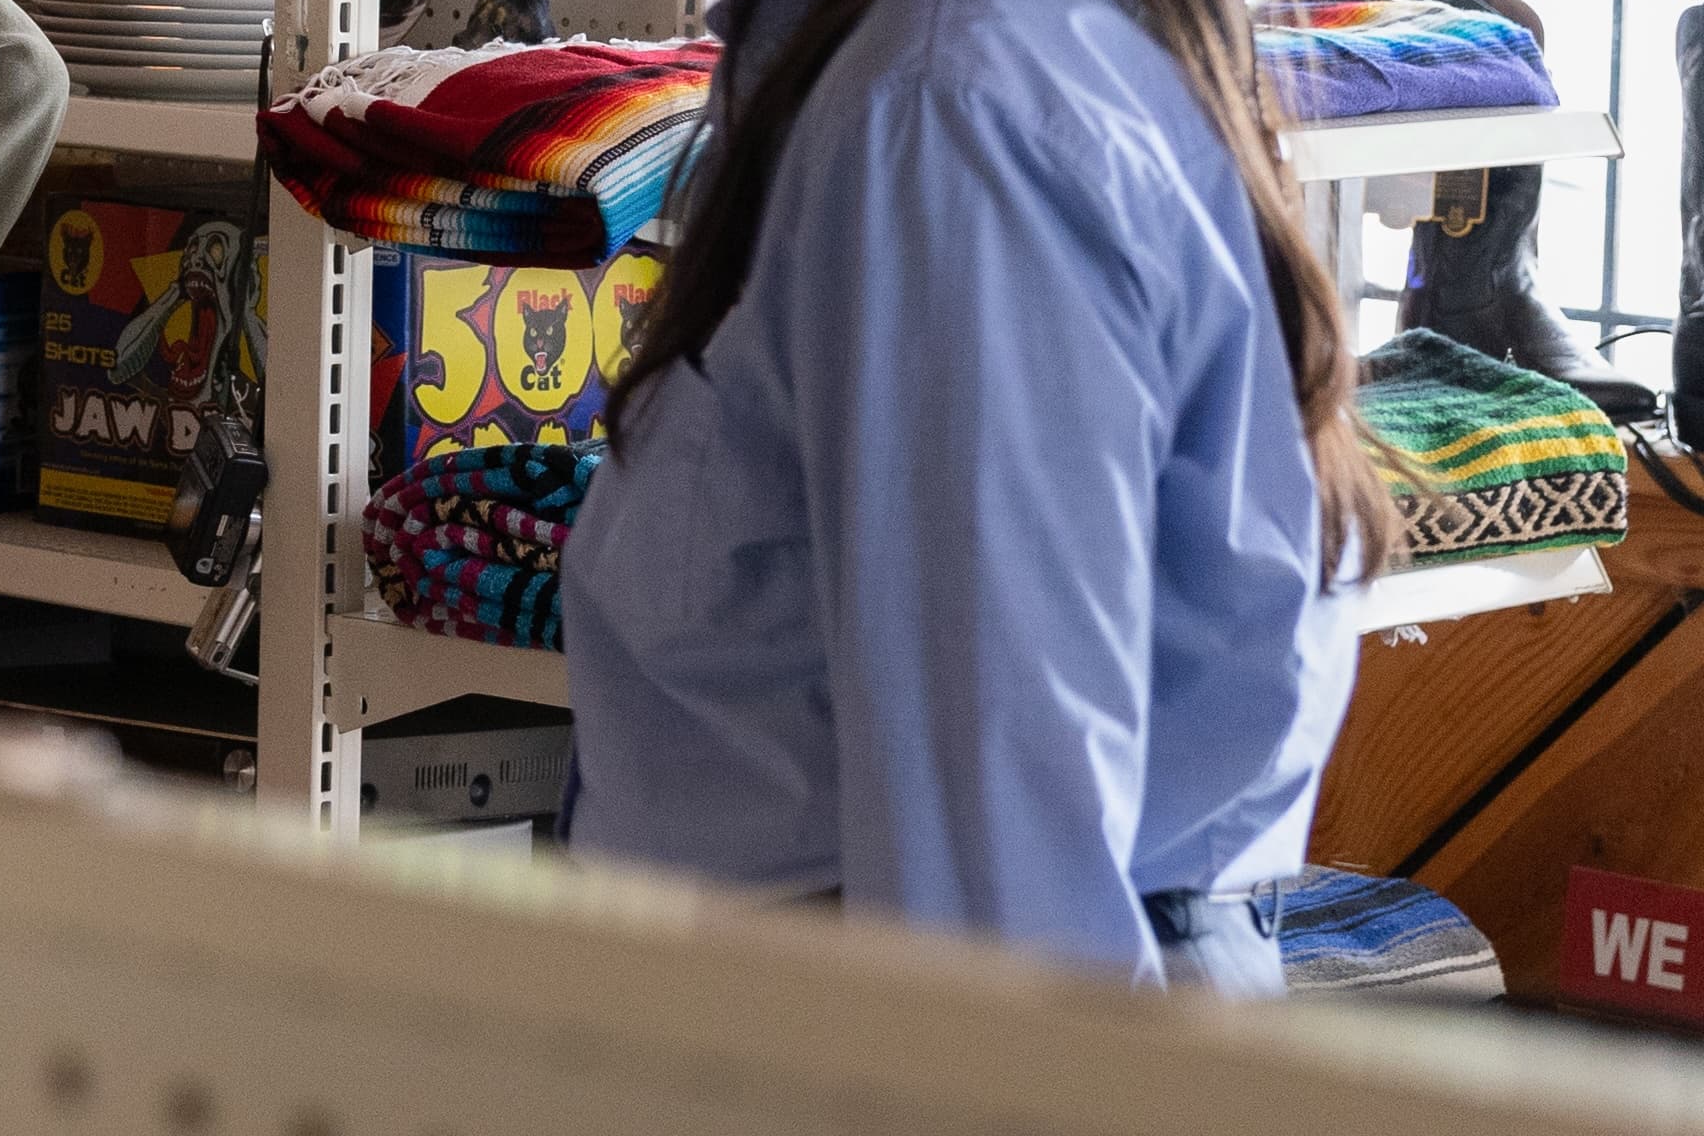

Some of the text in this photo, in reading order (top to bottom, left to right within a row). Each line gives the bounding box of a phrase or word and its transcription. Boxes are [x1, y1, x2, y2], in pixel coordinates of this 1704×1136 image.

[516, 288, 574, 314] Black
[46, 312, 72, 332] 25
[45, 341, 117, 369] SHOTS
[520, 365, 562, 391] Cat
[52, 387, 160, 449] JAW
[1592, 907, 1689, 992] WE
